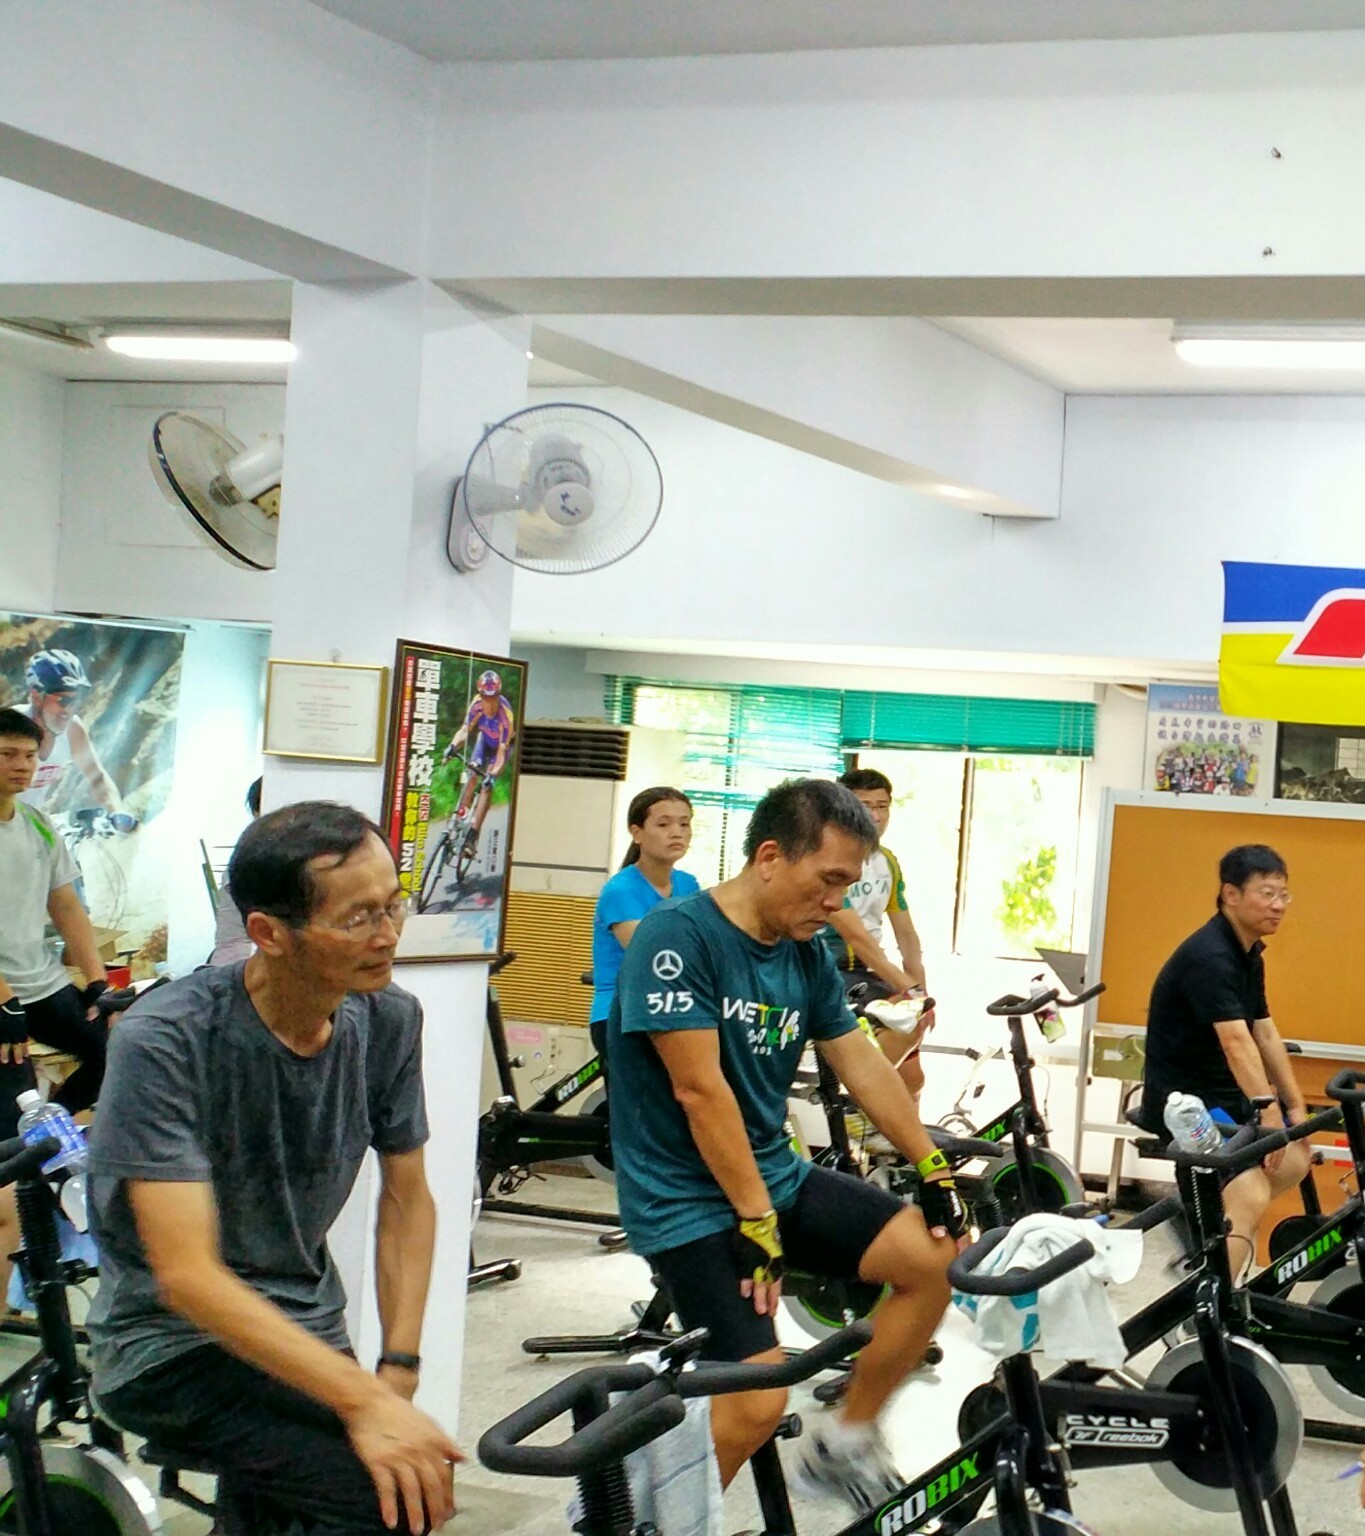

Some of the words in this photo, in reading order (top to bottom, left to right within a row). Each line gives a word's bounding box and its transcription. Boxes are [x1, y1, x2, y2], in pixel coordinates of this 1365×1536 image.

[408, 658, 442, 787] 單車學校
[1277, 1225, 1343, 1285] ROBIX
[1065, 1414, 1170, 1430] CYCLE
[1102, 1432, 1160, 1444] reebok
[880, 1451, 980, 1536] ROBIX
